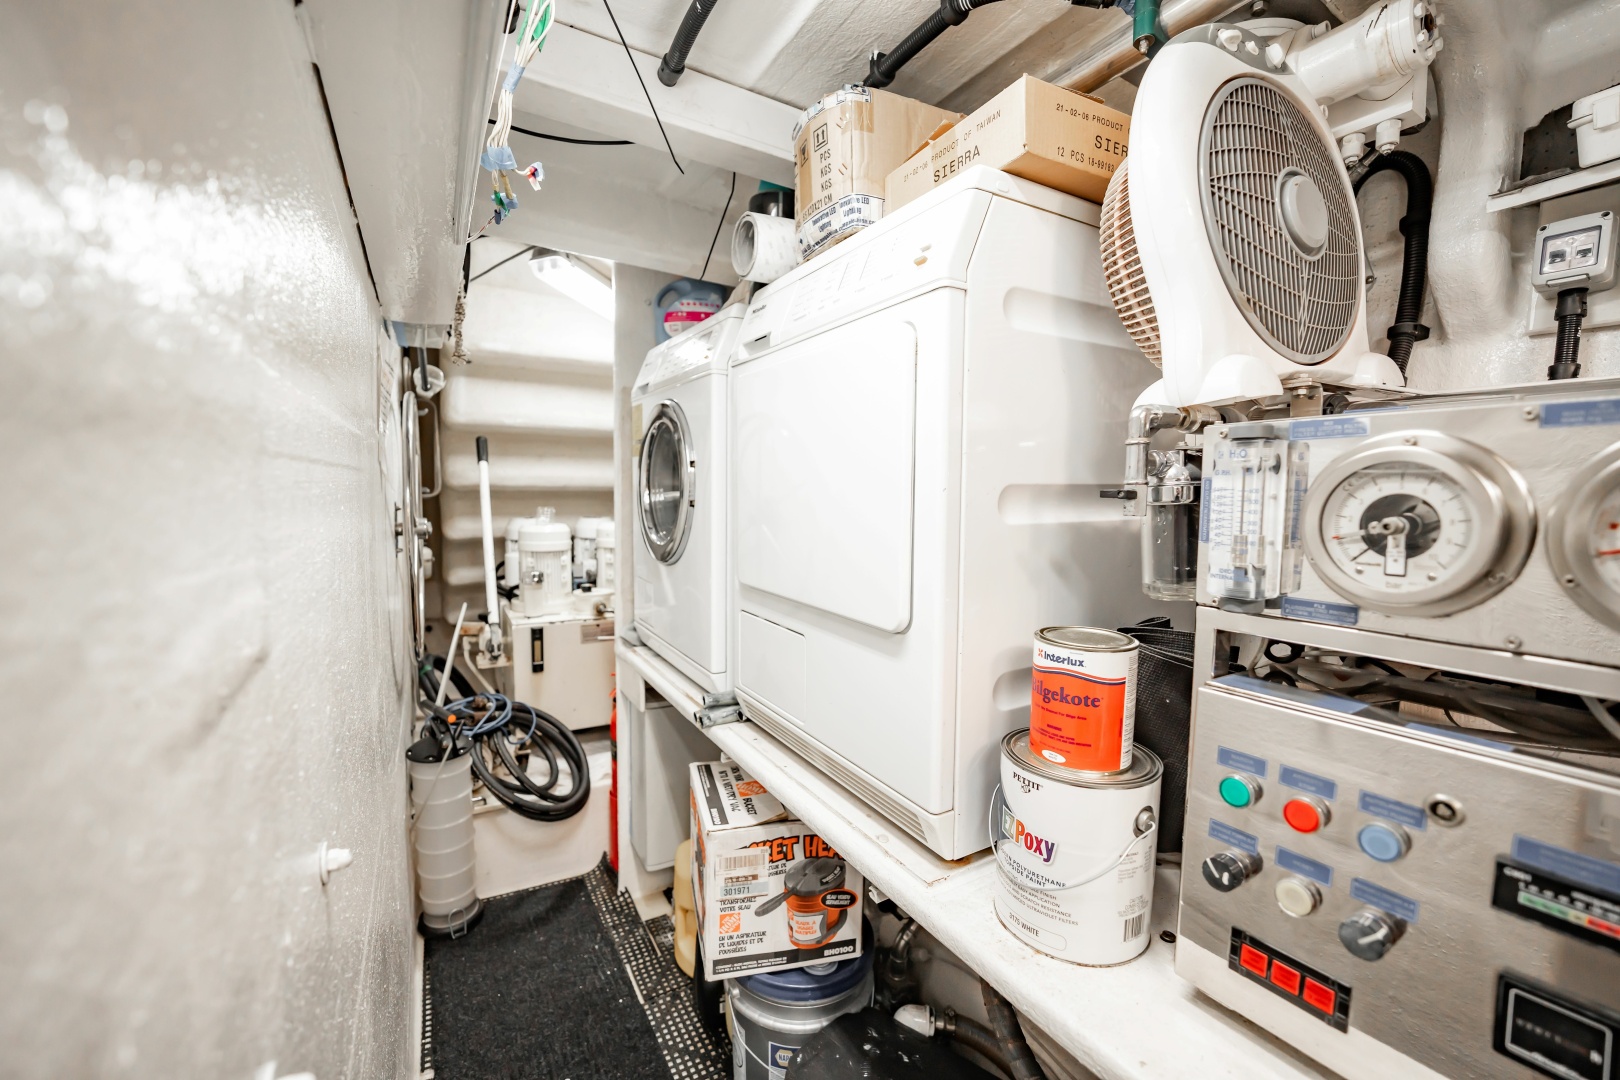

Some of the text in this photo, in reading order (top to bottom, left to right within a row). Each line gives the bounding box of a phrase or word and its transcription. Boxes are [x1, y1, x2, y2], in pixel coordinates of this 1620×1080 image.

[1092, 114, 1123, 131] PRODUCT
[931, 138, 960, 161] PRODUCT
[963, 129, 972, 141] OF
[976, 110, 1001, 132] TAIWAN
[1094, 134, 1129, 157] SIER
[820, 148, 832, 163] PCS
[1057, 146, 1065, 157] 12
[1070, 149, 1085, 163] PCS
[820, 163, 832, 178] KGS
[933, 144, 981, 183] SIERRA
[820, 178, 833, 193] KGS
[823, 192, 833, 206] CM
[861, 197, 870, 205] LED
[829, 206, 837, 216] LED
[1043, 650, 1085, 668] Interlux
[1032, 676, 1101, 709] Bilgekote
[1013, 771, 1041, 791] PETTIT
[803, 834, 847, 862] HEA
[1012, 859, 1067, 888] POLYURETHANE
[1025, 874, 1047, 888] PAINT
[723, 886, 750, 897] 301971
[1028, 891, 1061, 908] APPLICATION
[1039, 890, 1057, 900] FINISH
[1026, 903, 1057, 920] ULTRAVIOLET
[1058, 916, 1079, 926] FILTERS
[1040, 903, 1072, 918] RESISTANCE
[1020, 922, 1040, 937] WHITE
[778, 1053, 791, 1061] NAP
